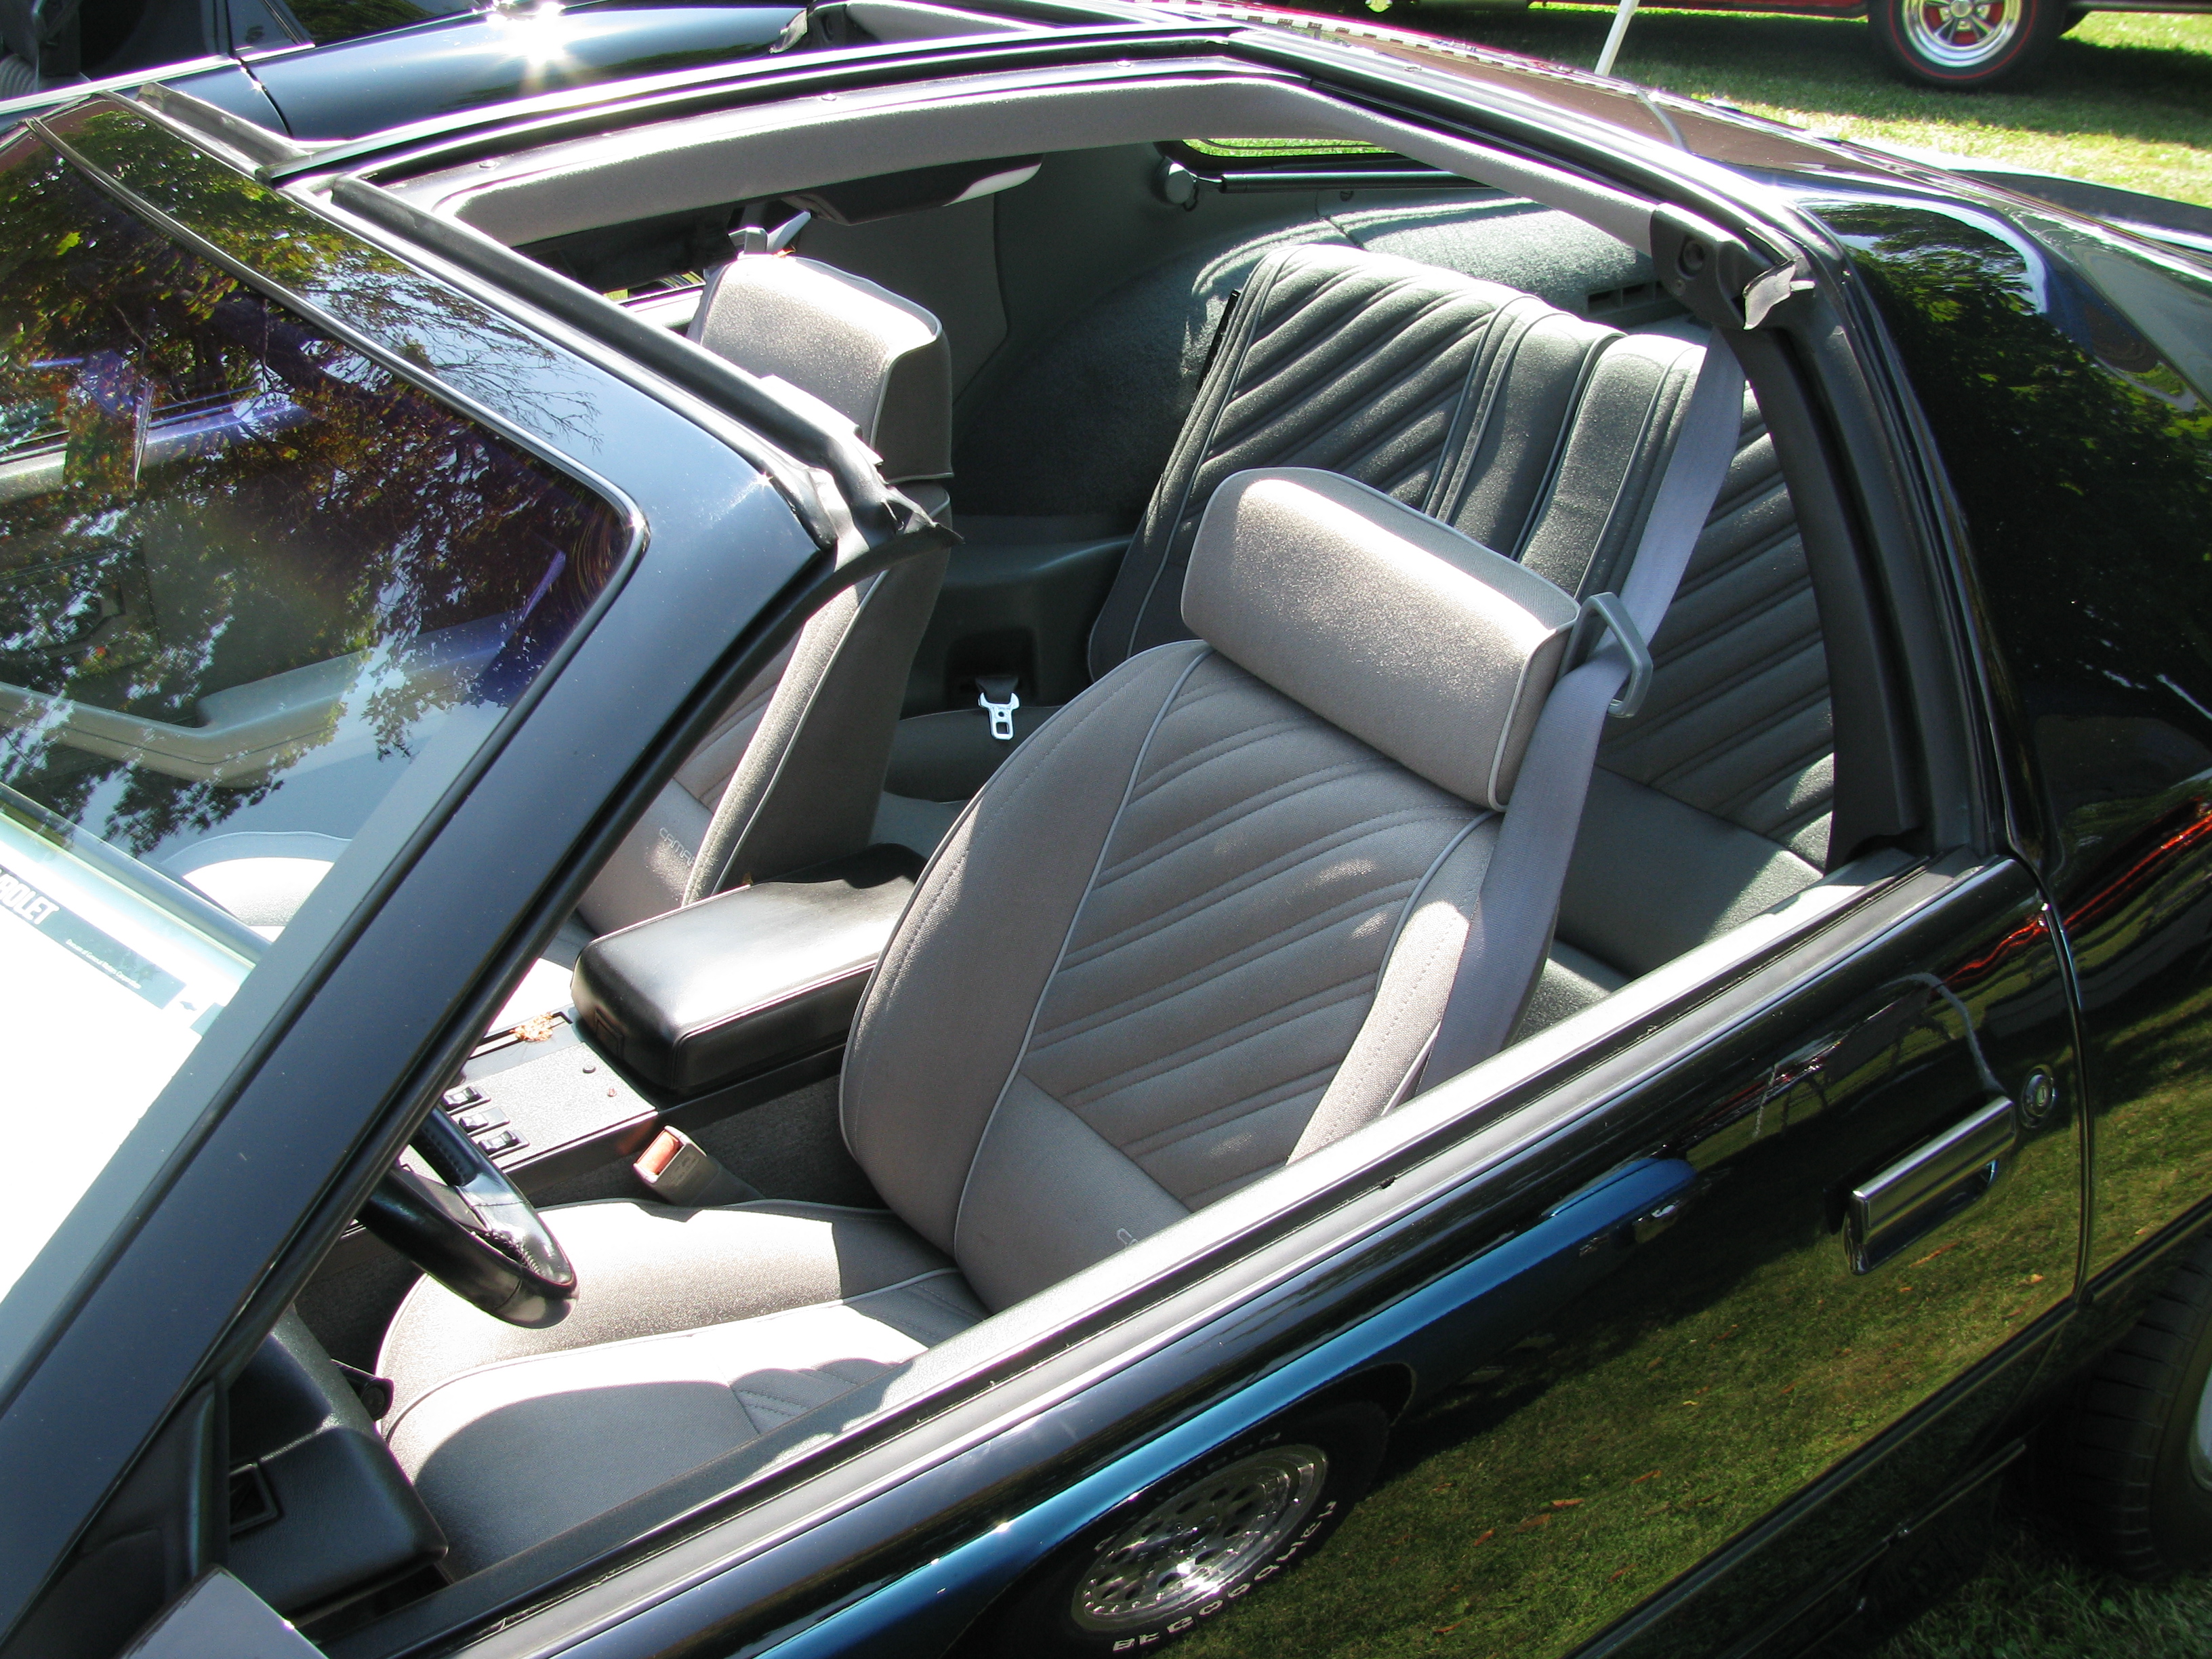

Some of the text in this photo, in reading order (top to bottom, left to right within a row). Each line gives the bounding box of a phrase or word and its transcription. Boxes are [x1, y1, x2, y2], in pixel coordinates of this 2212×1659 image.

[65, 939, 83, 952] Division
[85, 951, 103, 965] General
[102, 960, 117, 974] Motors
[115, 970, 142, 989] Corporation
